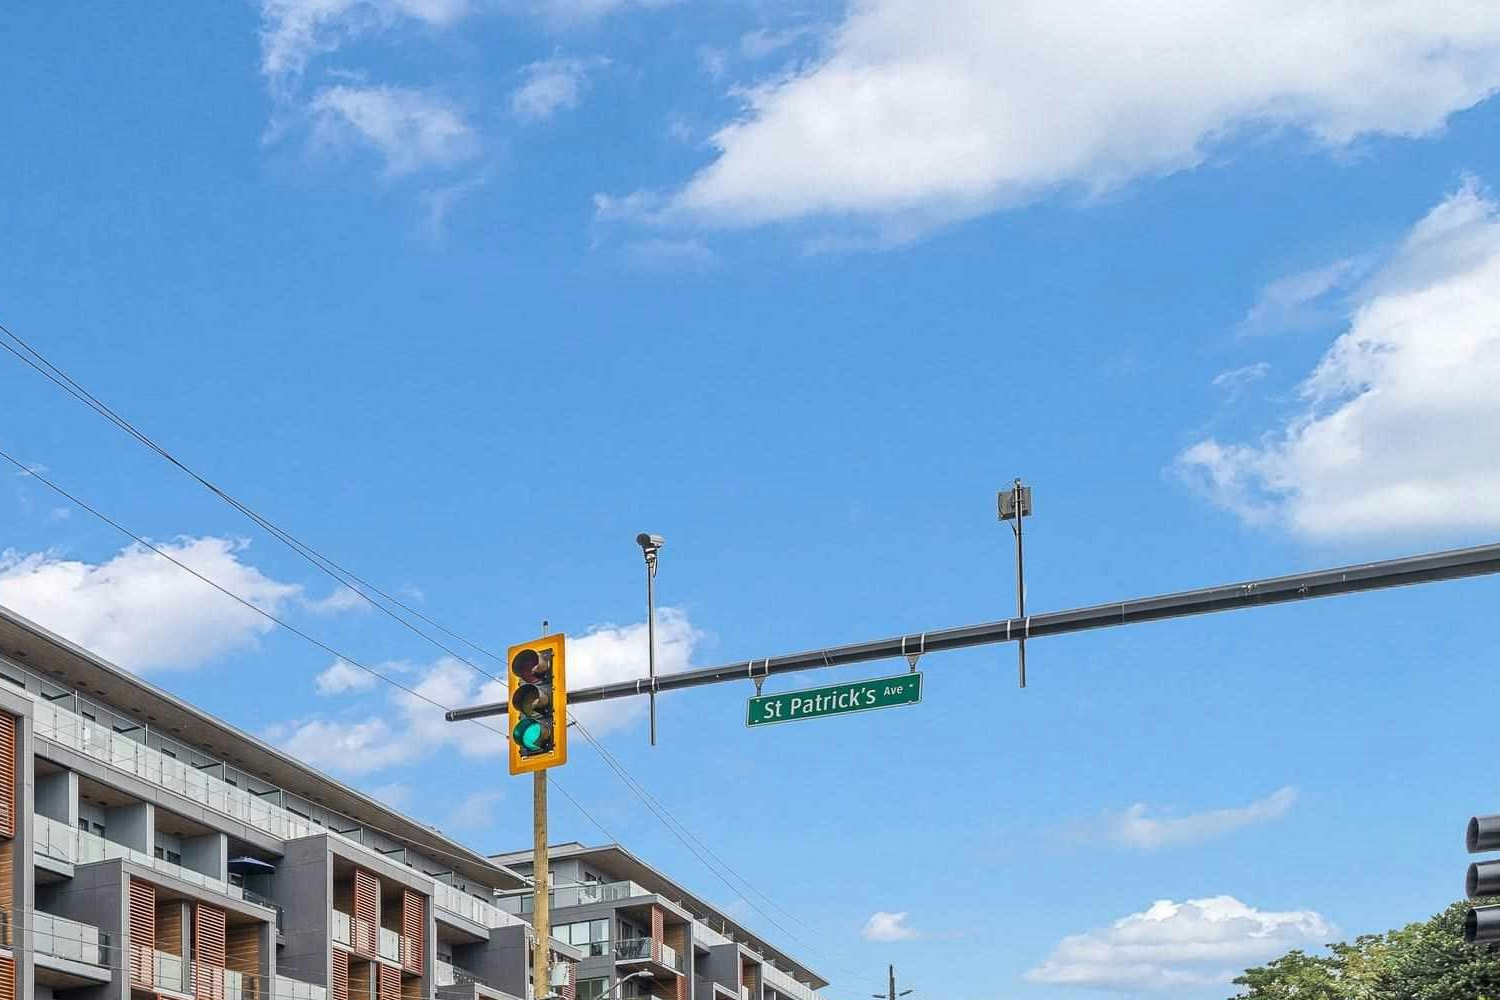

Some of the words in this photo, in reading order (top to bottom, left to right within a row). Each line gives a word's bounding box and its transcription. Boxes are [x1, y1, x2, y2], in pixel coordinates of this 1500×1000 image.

[764, 701, 782, 719] St
[790, 688, 876, 716] Patrick's
[884, 685, 903, 696] Ave
